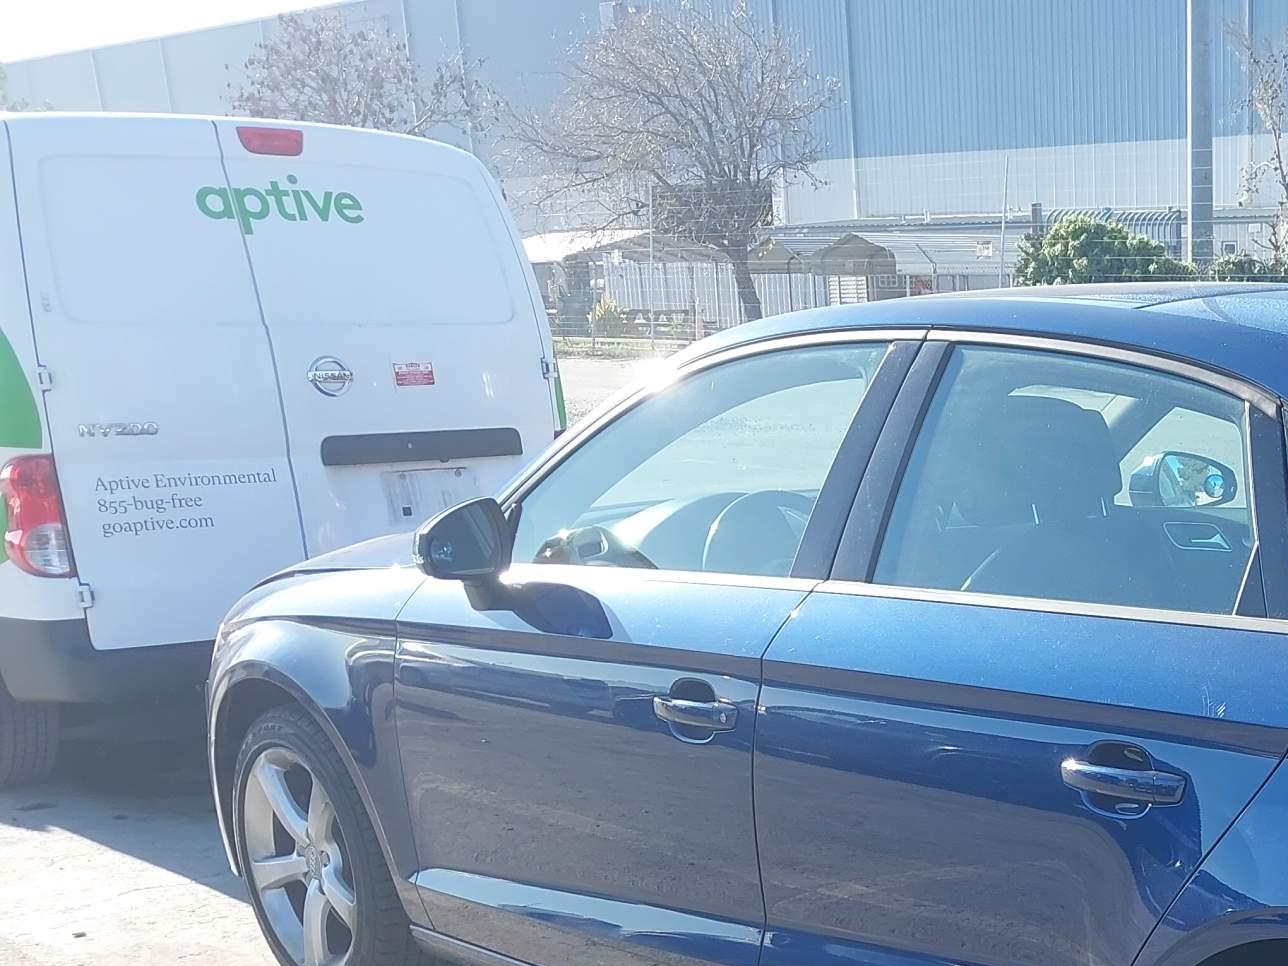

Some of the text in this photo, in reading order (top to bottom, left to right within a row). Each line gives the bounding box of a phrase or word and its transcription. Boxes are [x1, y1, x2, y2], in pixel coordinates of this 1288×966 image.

[195, 174, 365, 235] aptive
[313, 370, 351, 381] NISSAN
[78, 421, 159, 437] NV200
[95, 468, 278, 494] Aptive Environmental
[97, 493, 204, 514] 855-bug-free
[102, 514, 215, 538] goaptive.com
